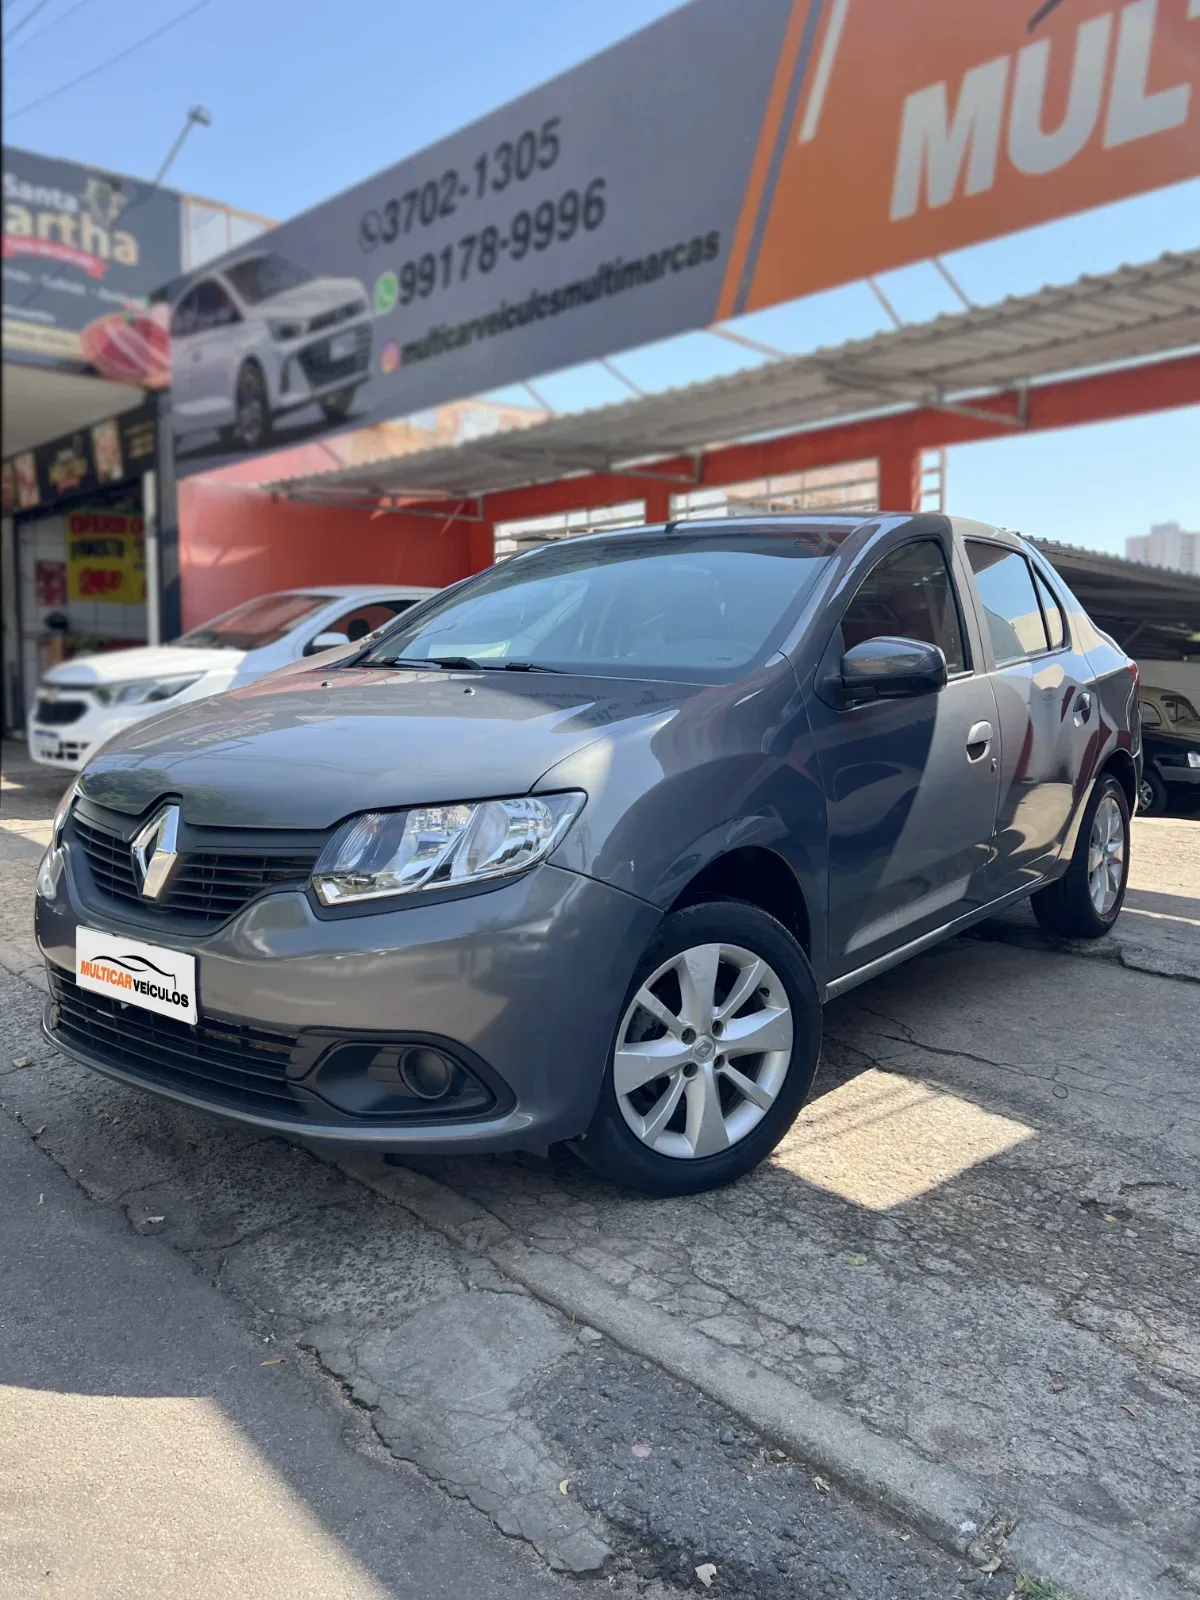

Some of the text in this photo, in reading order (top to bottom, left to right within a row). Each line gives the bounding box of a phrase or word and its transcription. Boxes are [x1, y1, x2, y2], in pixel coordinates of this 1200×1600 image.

[889, 0, 1200, 223] MUL
[3, 172, 79, 212] Santa
[380, 116, 561, 245] 3702-1305
[398, 176, 607, 307] 99178-9996
